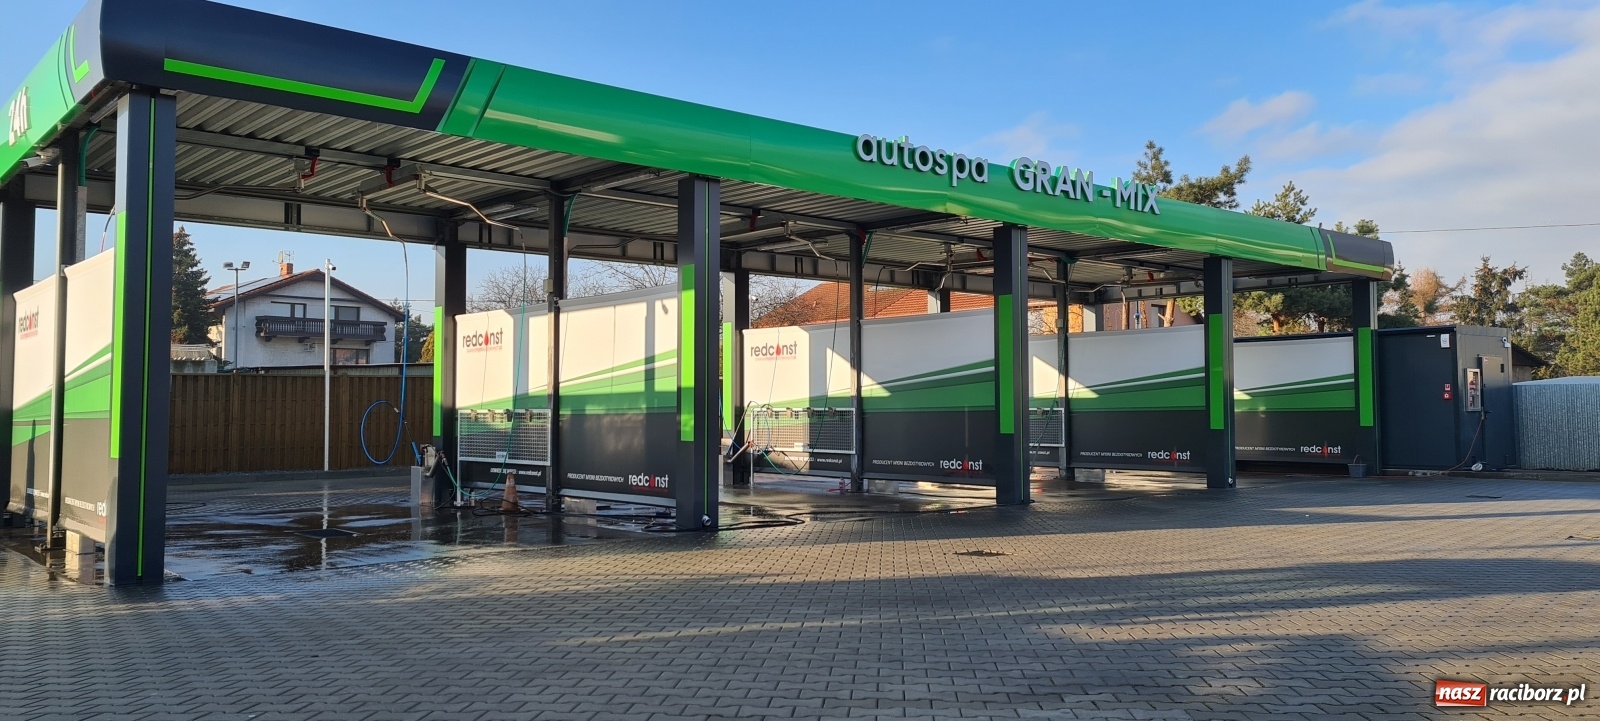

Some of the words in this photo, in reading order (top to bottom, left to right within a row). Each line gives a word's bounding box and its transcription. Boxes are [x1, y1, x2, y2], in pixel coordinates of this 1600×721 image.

[8, 86, 31, 146] 24h
[856, 133, 988, 187] autospa
[1012, 156, 1094, 202] GRAN
[1113, 176, 1160, 215] MIX
[462, 327, 503, 348] redconst
[750, 340, 798, 357] redconst
[1148, 449, 1191, 460] redconst
[1300, 445, 1342, 454] redconst
[940, 458, 983, 471] redconst
[628, 472, 669, 489] redconst
